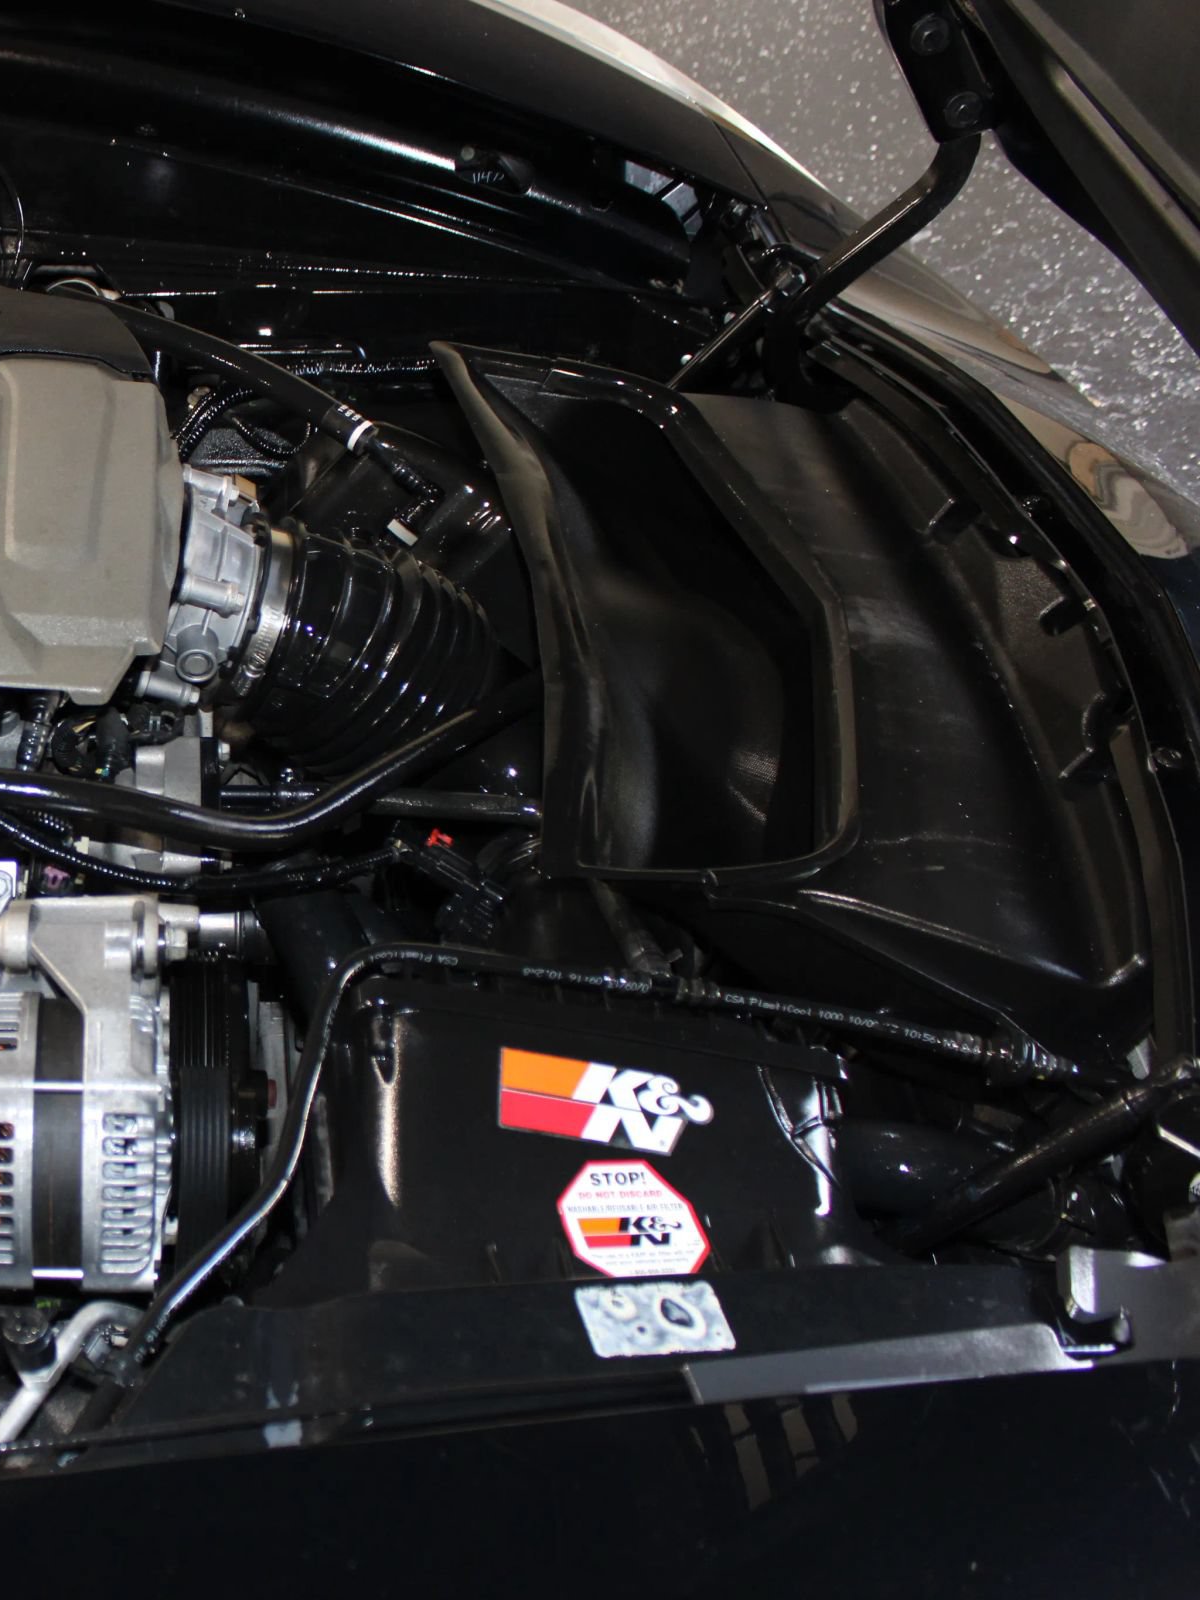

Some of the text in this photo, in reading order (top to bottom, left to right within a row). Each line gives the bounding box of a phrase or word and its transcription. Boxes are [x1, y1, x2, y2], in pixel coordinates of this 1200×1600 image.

[724, 993, 746, 1005] CSA
[748, 997, 812, 1017] PlastiCool
[571, 1062, 714, 1155] K&N
[589, 1171, 646, 1187] STOP!
[578, 1189, 663, 1200] DO NOT DISCARD
[619, 1216, 683, 1247] K&N
